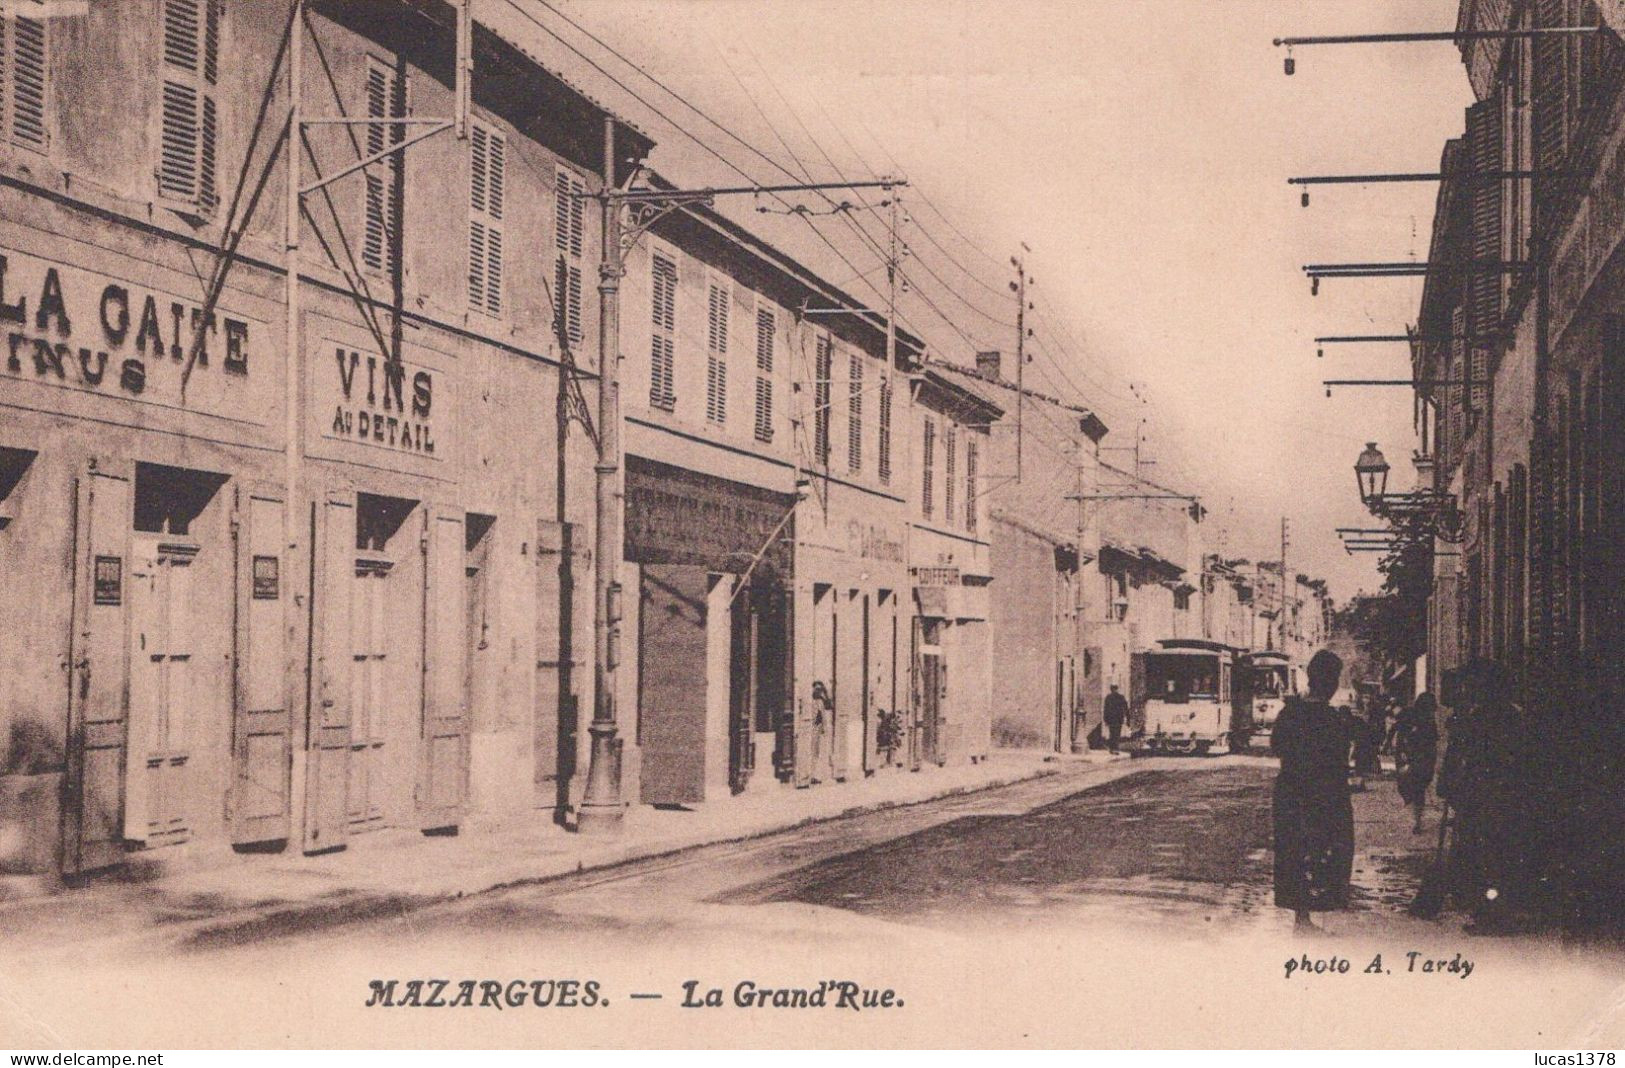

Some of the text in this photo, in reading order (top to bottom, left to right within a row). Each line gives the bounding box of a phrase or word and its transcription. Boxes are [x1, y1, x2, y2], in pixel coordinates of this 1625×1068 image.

[0, 255, 248, 376] LA GAITE
[336, 348, 432, 418] VINS
[359, 411, 434, 452] DETAIL
